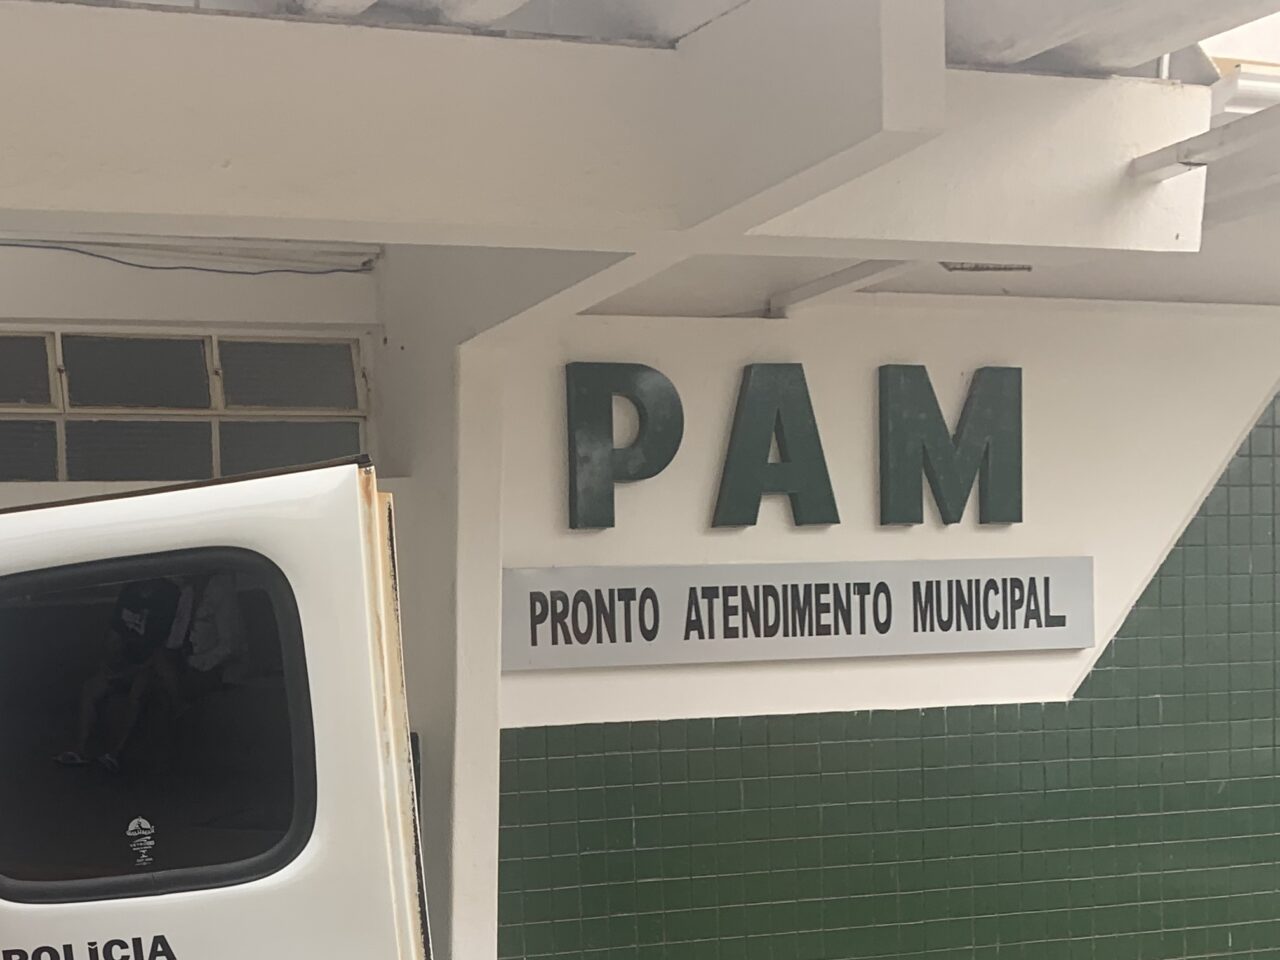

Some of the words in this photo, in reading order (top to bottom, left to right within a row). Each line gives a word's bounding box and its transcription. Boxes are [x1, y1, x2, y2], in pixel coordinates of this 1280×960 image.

[565, 362, 1023, 529] PAM
[529, 587, 660, 646] PRONTO
[684, 581, 892, 640] ATENDIMENTO
[912, 576, 1067, 632] MUNICIPAL
